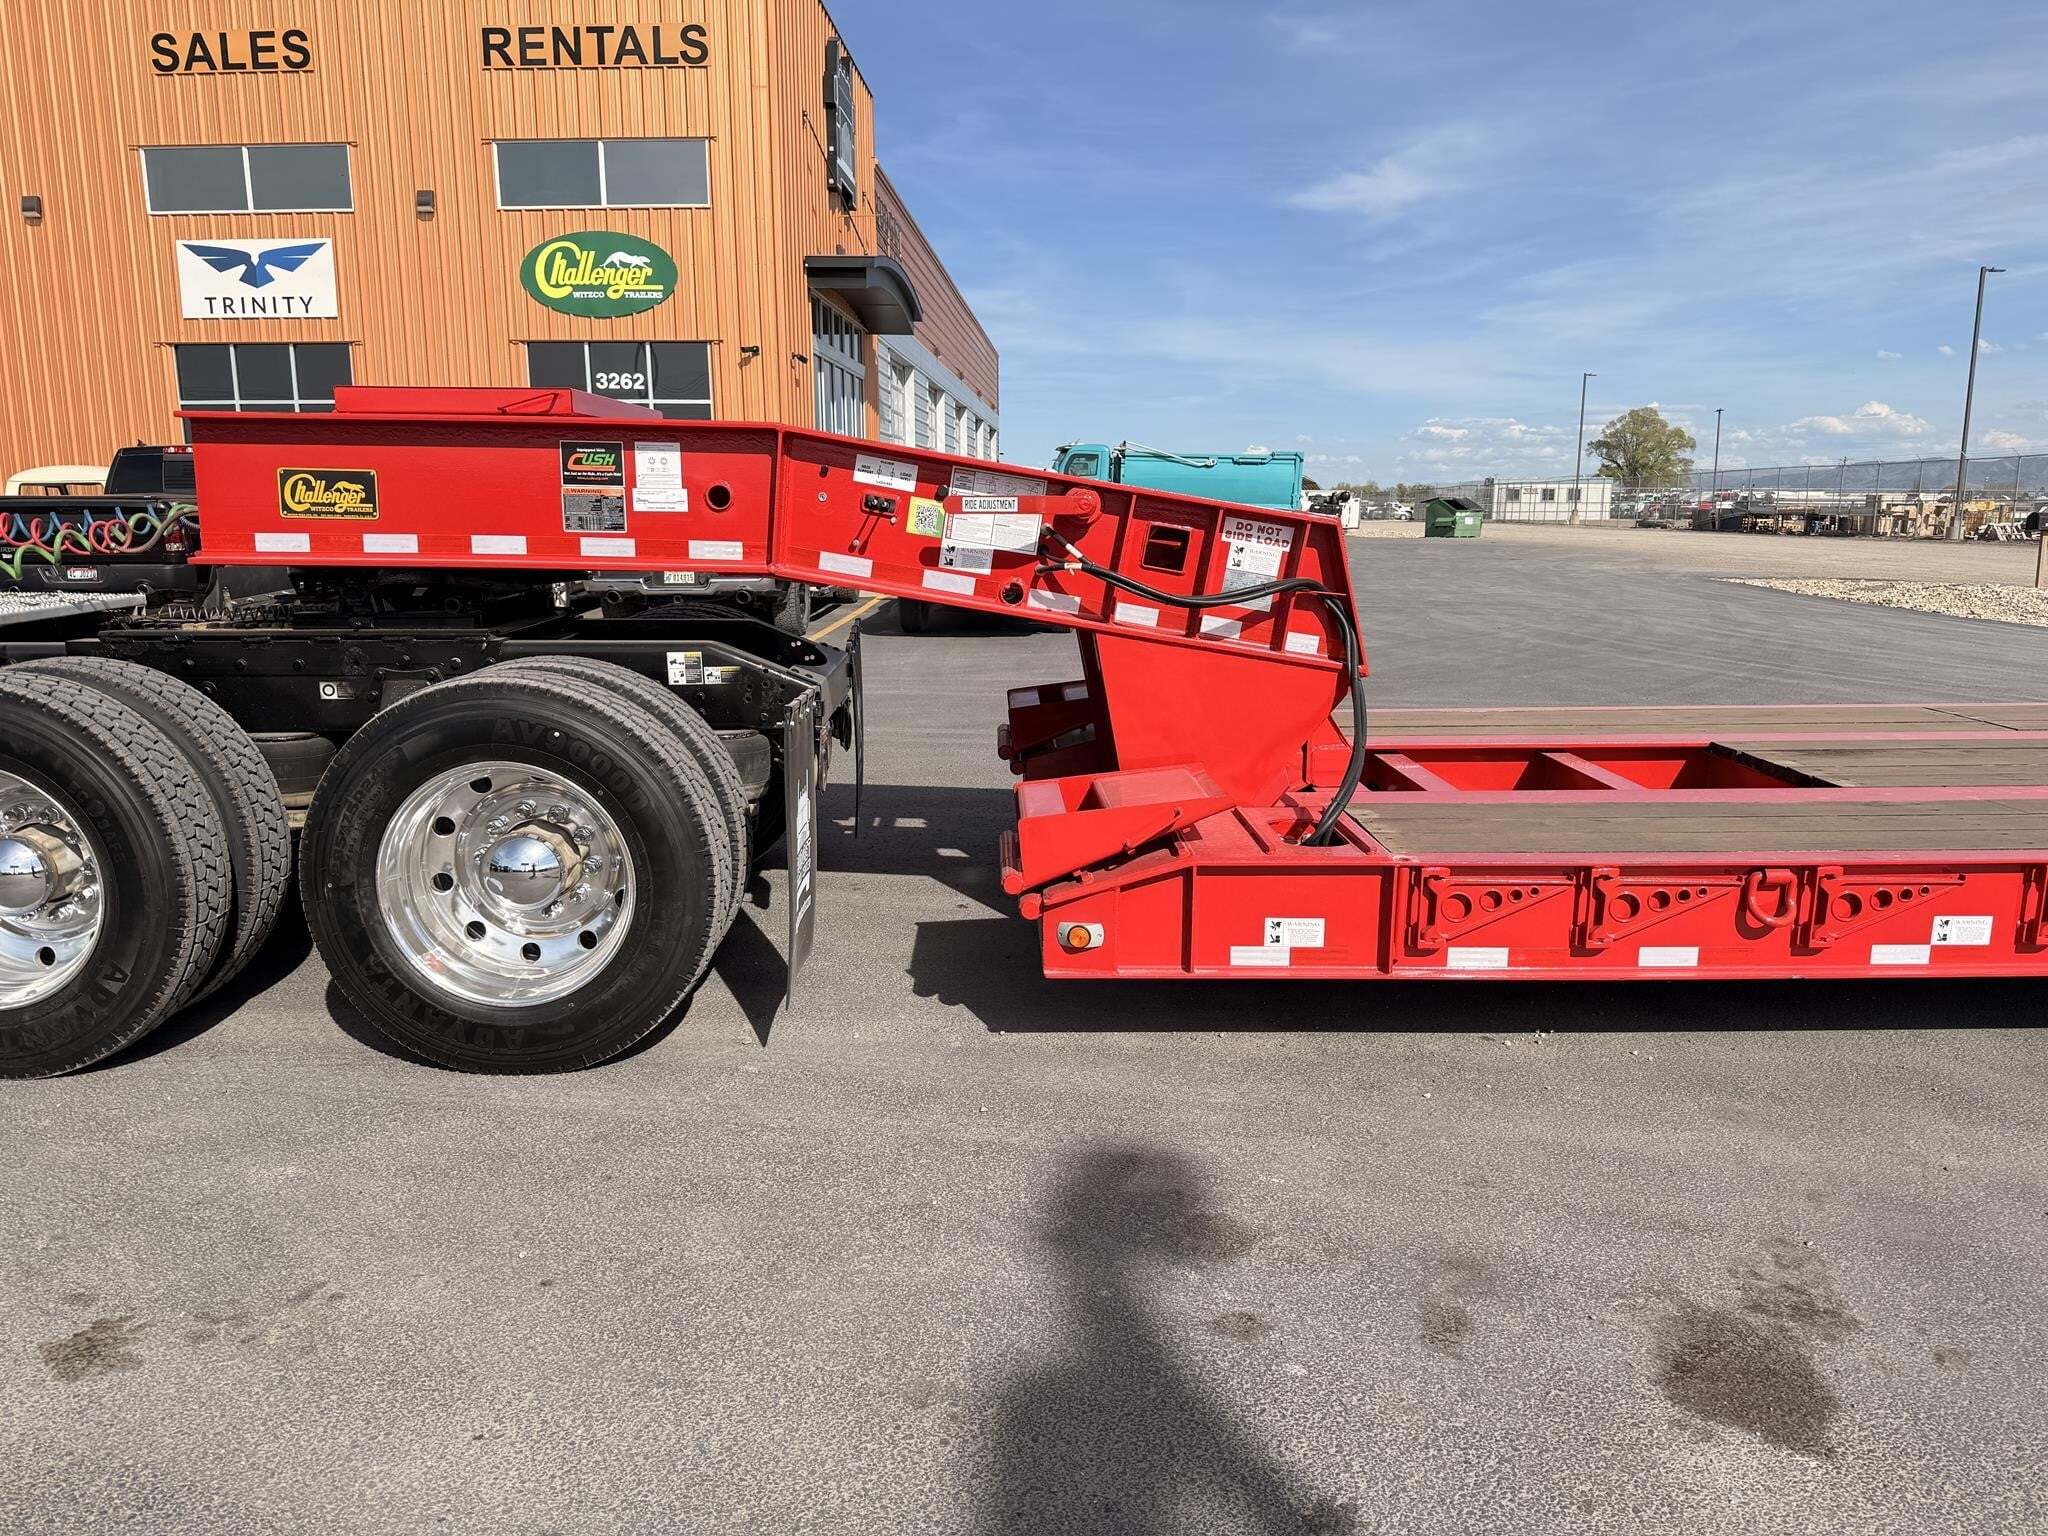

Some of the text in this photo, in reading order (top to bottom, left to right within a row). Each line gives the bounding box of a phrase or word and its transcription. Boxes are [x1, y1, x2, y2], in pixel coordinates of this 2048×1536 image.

[151, 29, 311, 73] SALES
[481, 24, 709, 67] RENTALS
[535, 240, 664, 300] Challenger
[623, 291, 663, 299] TRAILERS
[204, 296, 313, 314] TRINITY
[595, 372, 645, 390] 3262
[567, 453, 616, 472] CUSH
[284, 473, 374, 513] Challenger
[964, 500, 1016, 510] RIDE ADJUSTMENT
[1224, 529, 1290, 548] SIDE LOAD
[1235, 521, 1283, 537] DO NOT
